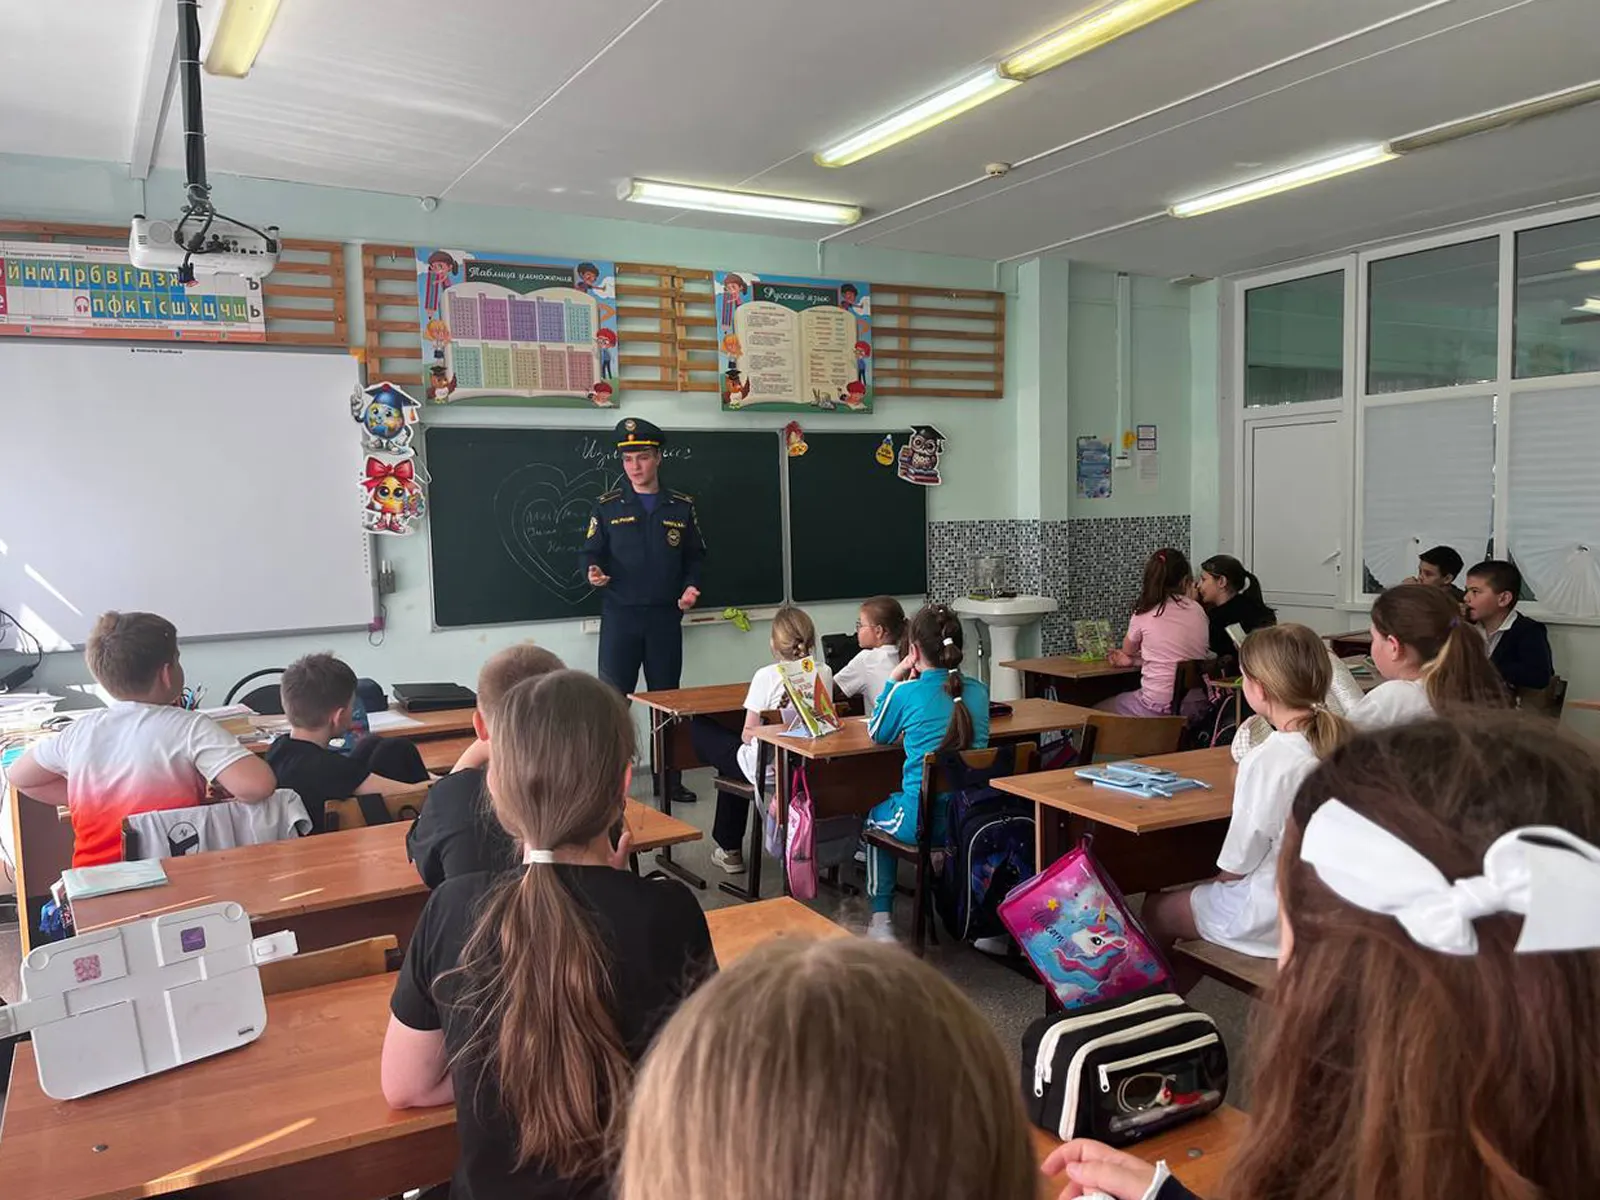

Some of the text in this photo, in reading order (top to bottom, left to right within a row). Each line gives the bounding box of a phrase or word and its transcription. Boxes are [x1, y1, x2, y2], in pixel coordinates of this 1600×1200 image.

[468, 266, 573, 283] Таблица умножения
[763, 286, 830, 305] Русский язык
